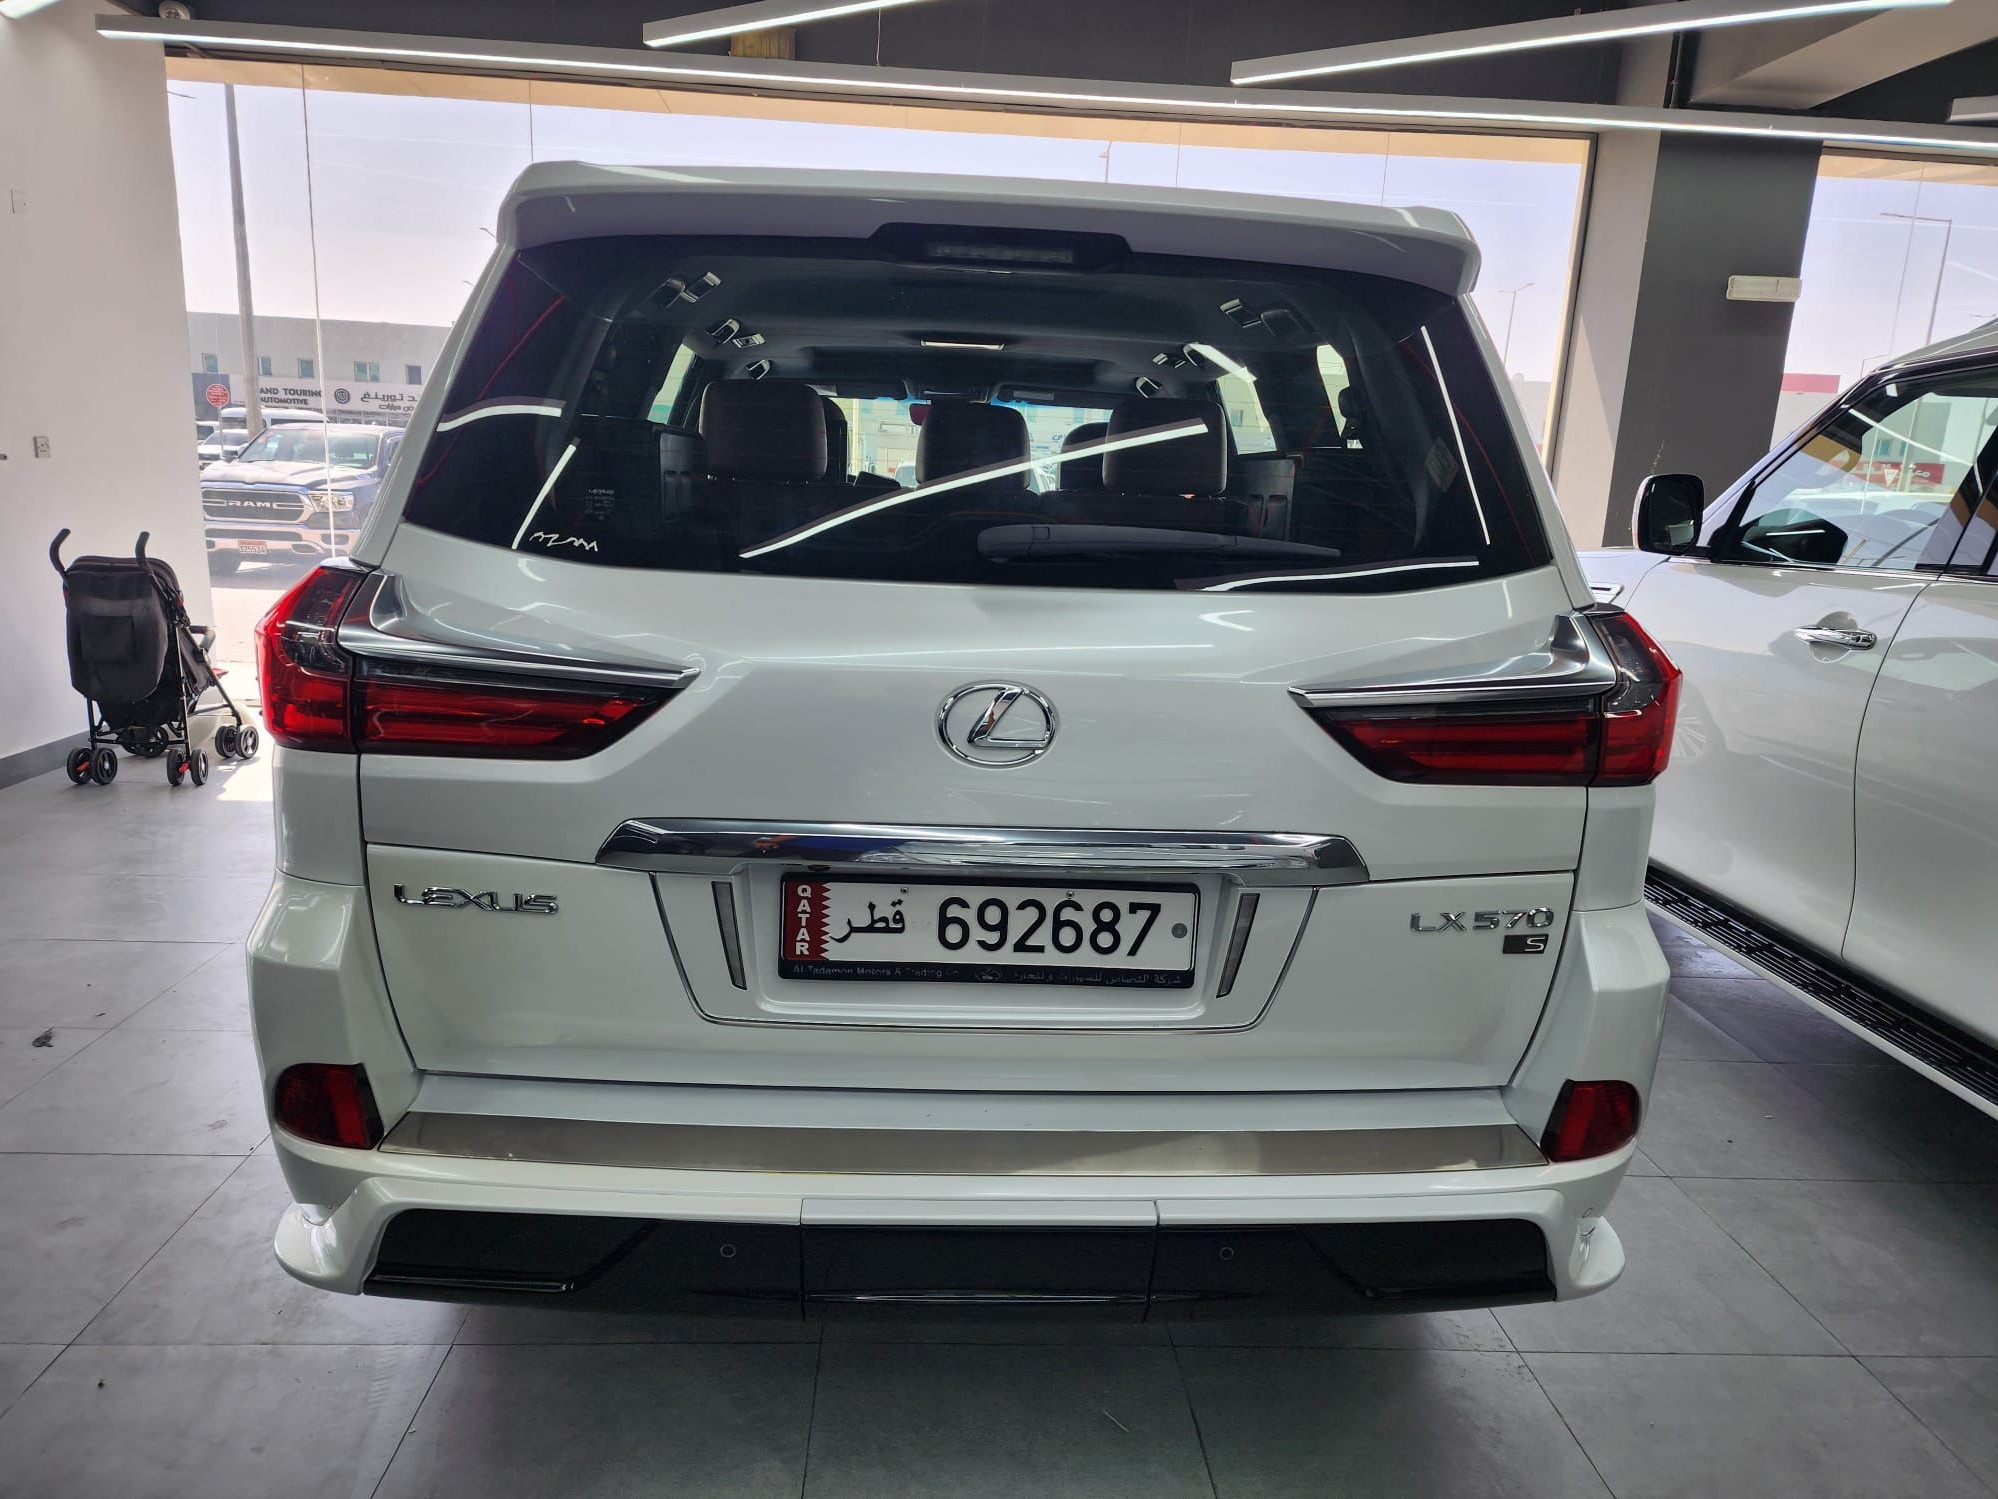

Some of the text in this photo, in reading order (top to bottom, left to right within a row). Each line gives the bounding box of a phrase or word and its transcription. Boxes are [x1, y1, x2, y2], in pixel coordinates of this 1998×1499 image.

[260, 387, 279, 395] AND
[228, 500, 270, 508] RAM
[394, 883, 559, 914] LEXUS
[795, 884, 812, 955] QATAR
[829, 898, 906, 943] قطر
[938, 896, 1162, 956] 692687
[1524, 935, 1547, 952] S
[856, 967, 891, 977] Motors
